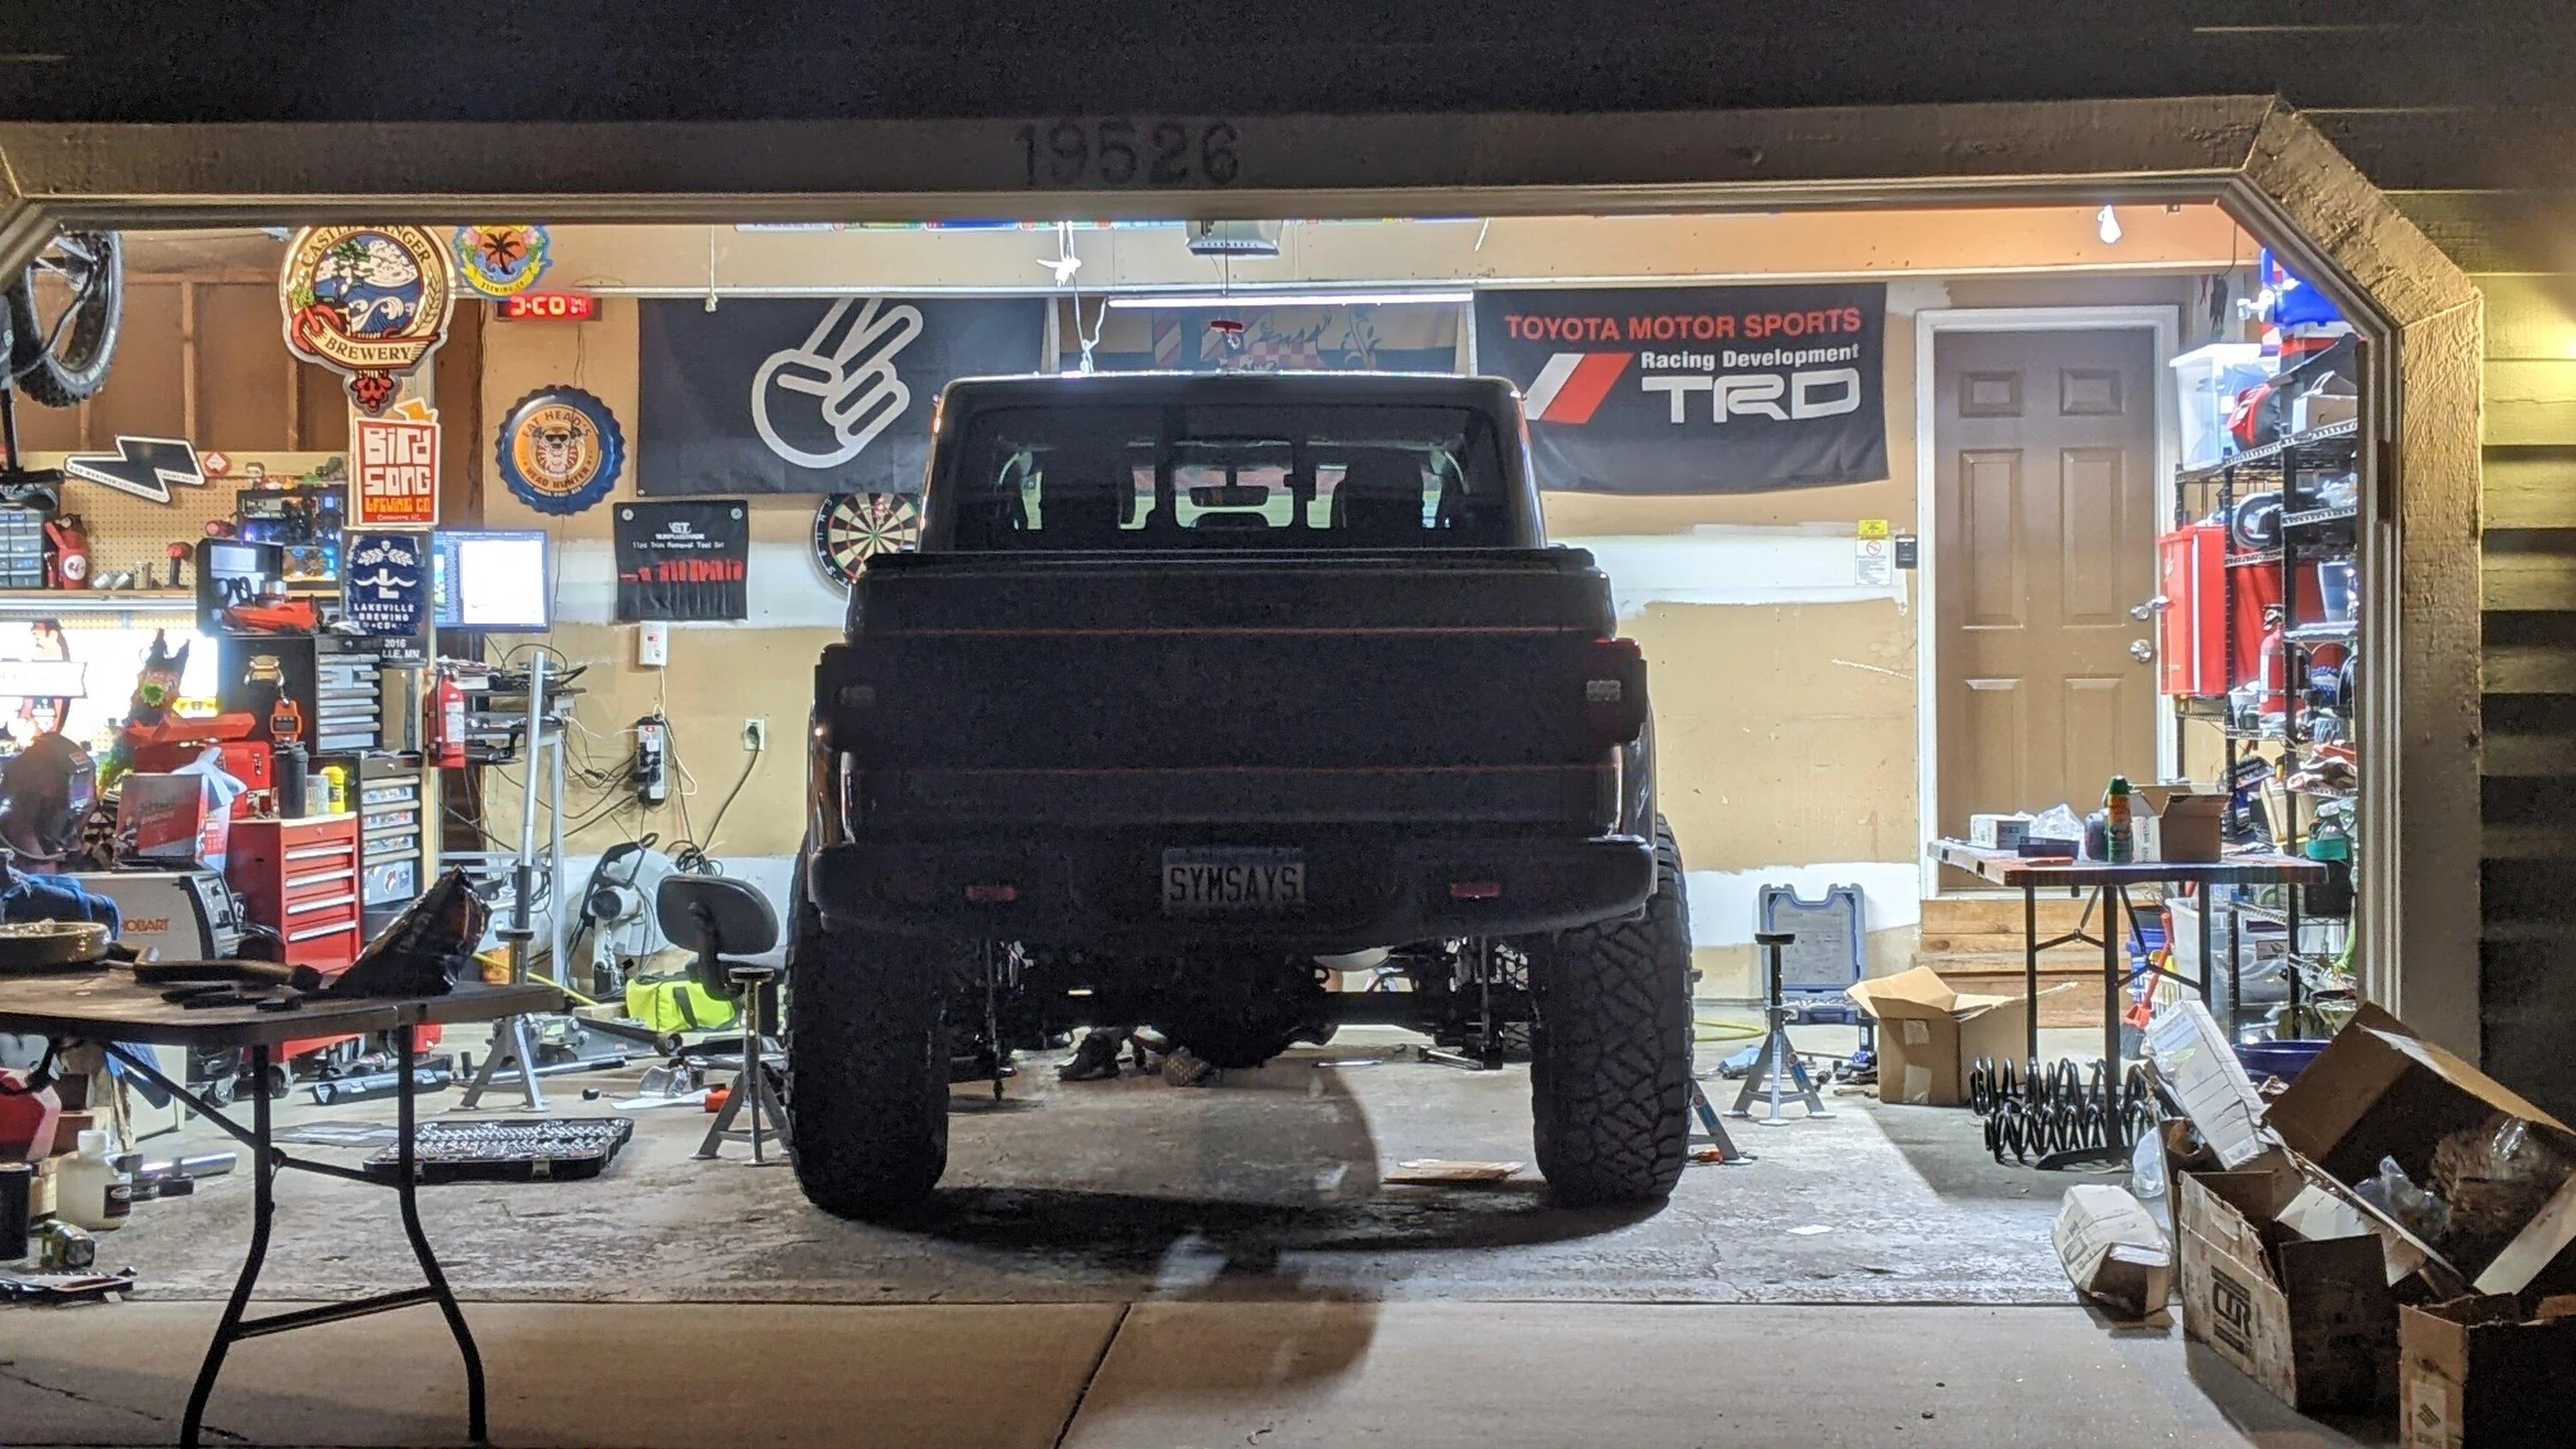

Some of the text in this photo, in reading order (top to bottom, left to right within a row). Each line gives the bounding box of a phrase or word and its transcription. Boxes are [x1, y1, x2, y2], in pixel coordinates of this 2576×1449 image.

[1013, 118, 1239, 187] 19526
[1504, 306, 1862, 342] TOYOTA MOTOR SPORTS
[325, 336, 412, 361] BREWERY
[1641, 343, 1861, 371] Racing Development
[1641, 367, 1862, 425] TRD
[521, 409, 592, 439] FAT HEAD'S
[526, 466, 550, 488] HEAD
[353, 603, 415, 613] LAKEVILLE
[359, 612, 410, 621] BREWING
[384, 638, 407, 649] 2016
[1169, 865, 1299, 903] SYMSAYS
